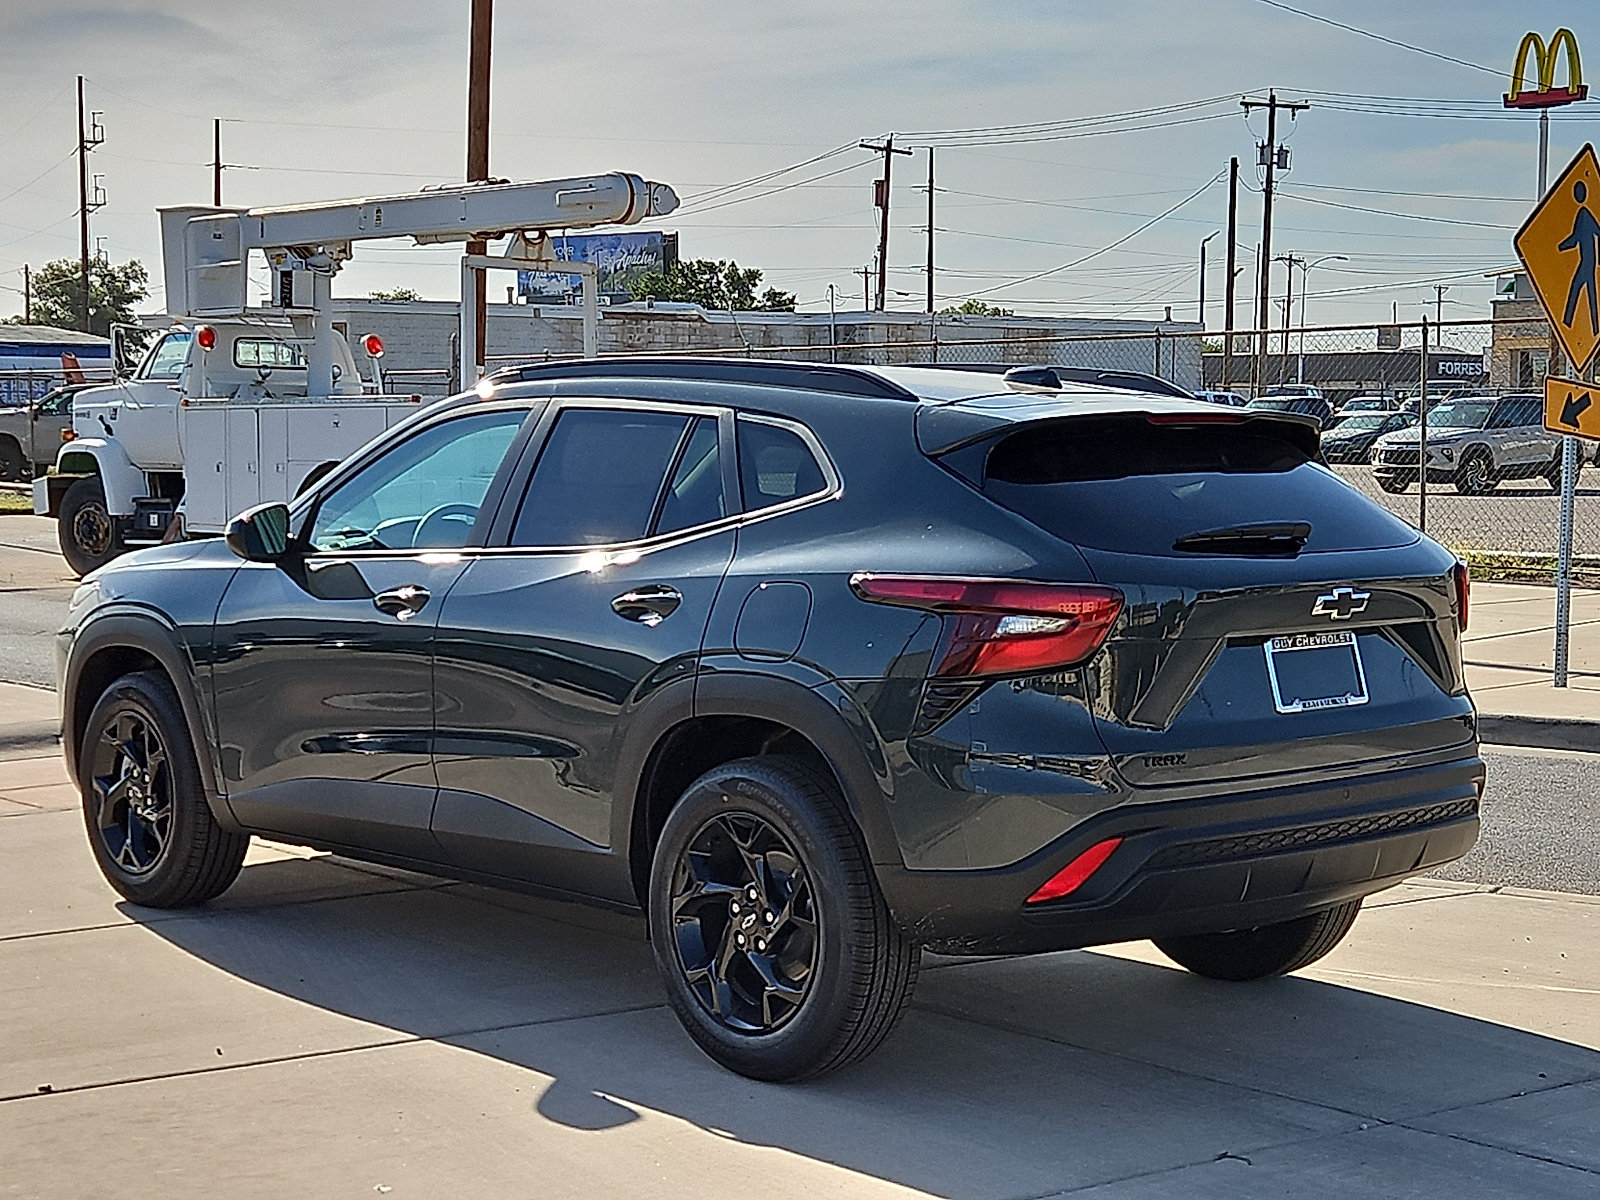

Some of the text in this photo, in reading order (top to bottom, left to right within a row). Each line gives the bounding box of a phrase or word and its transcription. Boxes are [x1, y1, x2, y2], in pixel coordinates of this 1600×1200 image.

[1274, 633, 1351, 649] GUY CHEVROLET
[1141, 753, 1187, 768] TRAX
